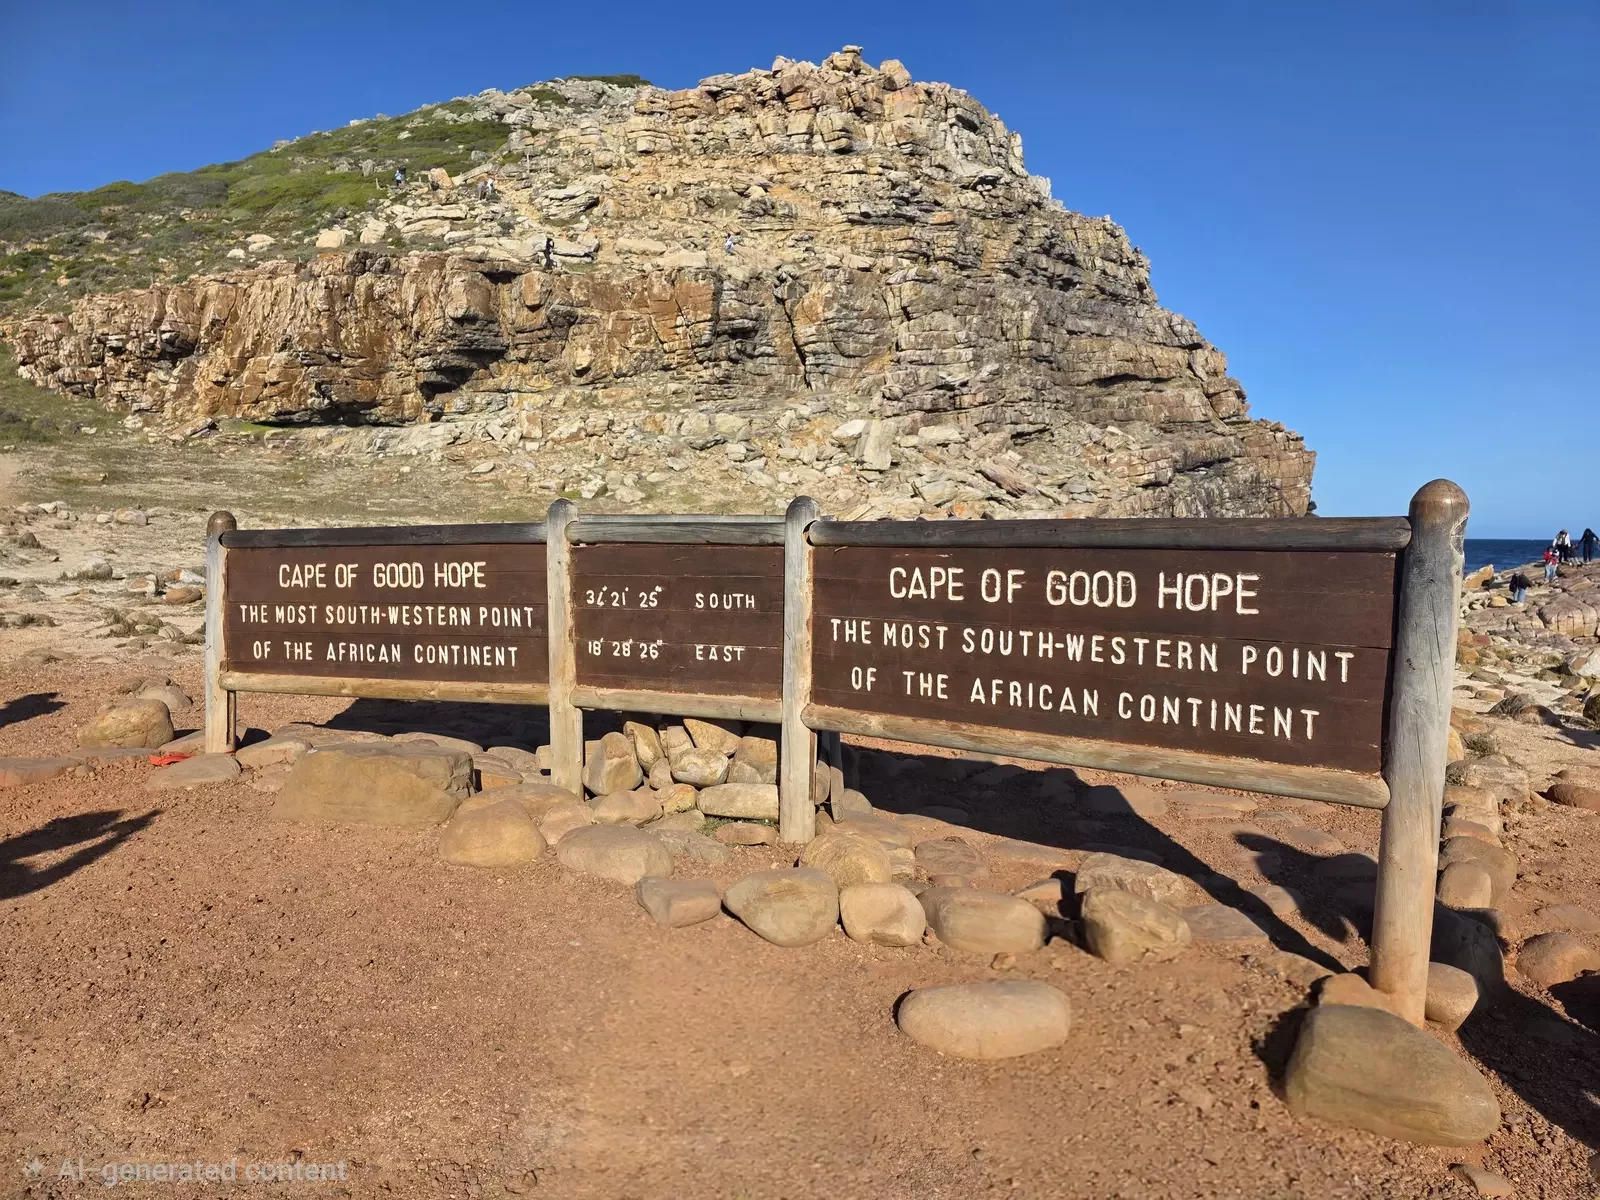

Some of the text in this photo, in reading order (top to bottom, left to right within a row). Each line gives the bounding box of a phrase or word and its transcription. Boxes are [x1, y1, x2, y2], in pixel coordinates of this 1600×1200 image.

[279, 561, 486, 588] CAPE OF GOOD HOPE
[695, 593, 755, 610] SOUTH
[889, 567, 1259, 615] CAPE OF GOOD HOPE
[240, 605, 534, 628] THE MOST SOUTH-WESTERN POINT
[253, 641, 518, 666] OF THE AFRICAN CONTINENT
[695, 644, 745, 662] EAST
[831, 619, 1354, 683] THE MOST SOUTH-WESTERN POINT
[851, 666, 1319, 740] OF THE AFRICAN CONTINENT
